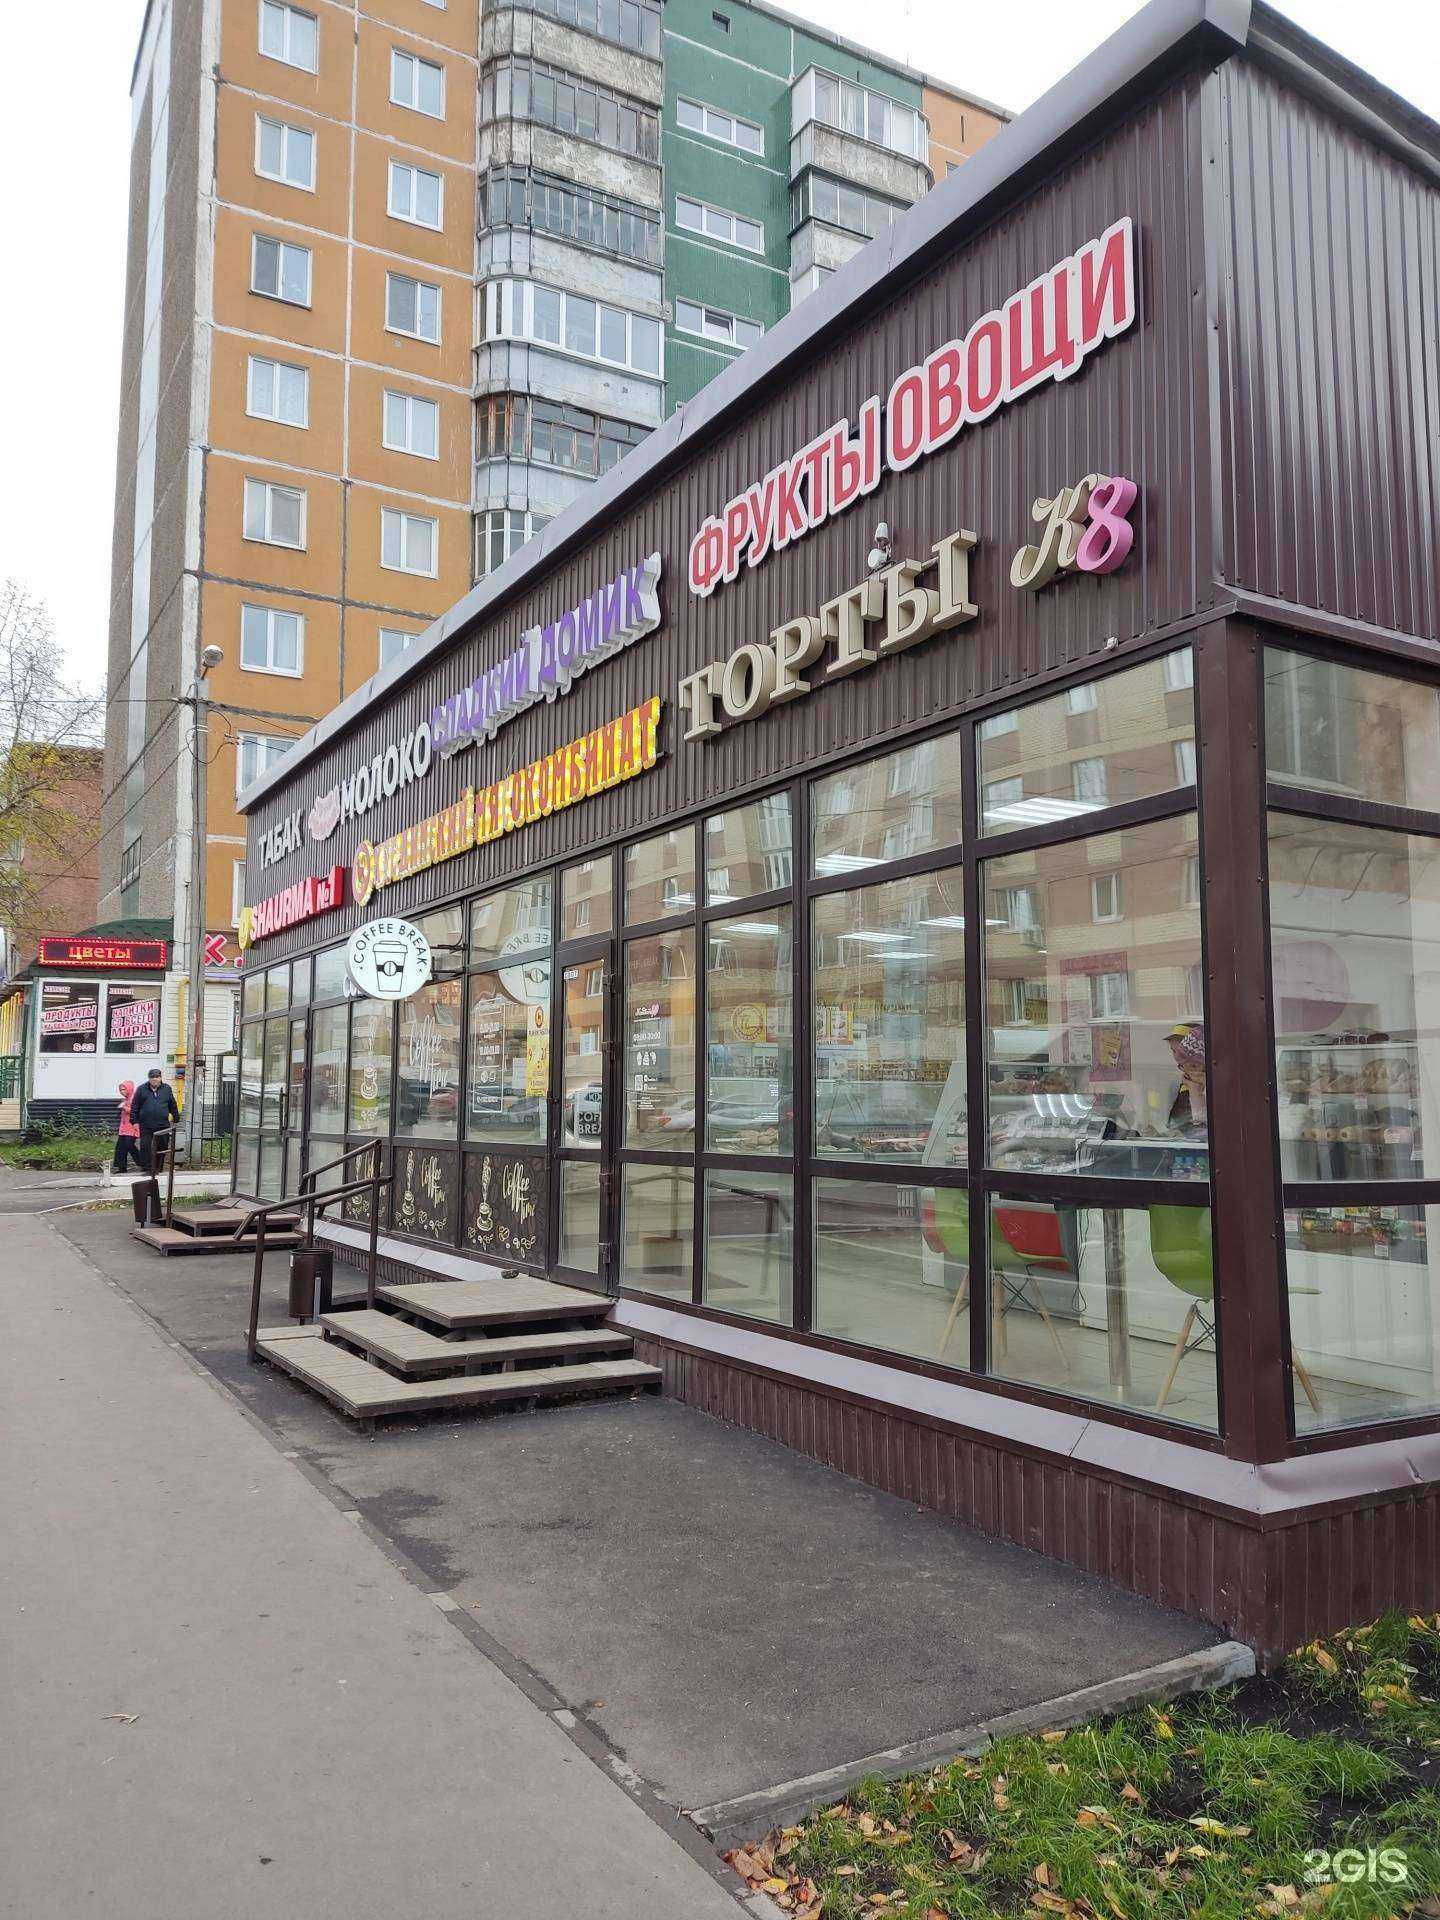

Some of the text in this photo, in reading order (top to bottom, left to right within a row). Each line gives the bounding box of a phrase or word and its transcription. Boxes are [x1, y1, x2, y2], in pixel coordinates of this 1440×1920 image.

[689, 219, 1134, 595] ФРУКТЫ ОВОЩИ
[432, 555, 657, 752] СЛАДКИЙ ДОМИК
[679, 529, 978, 742] ТОРТЫ
[339, 722, 431, 824] МОЛОКО
[258, 809, 301, 870] ТАБАК
[251, 876, 314, 940] SHAURMA
[353, 923, 428, 965] COFFEE BREAK
[112, 1024, 153, 1037] МИРА!
[502, 1162, 530, 1213] Coffee
